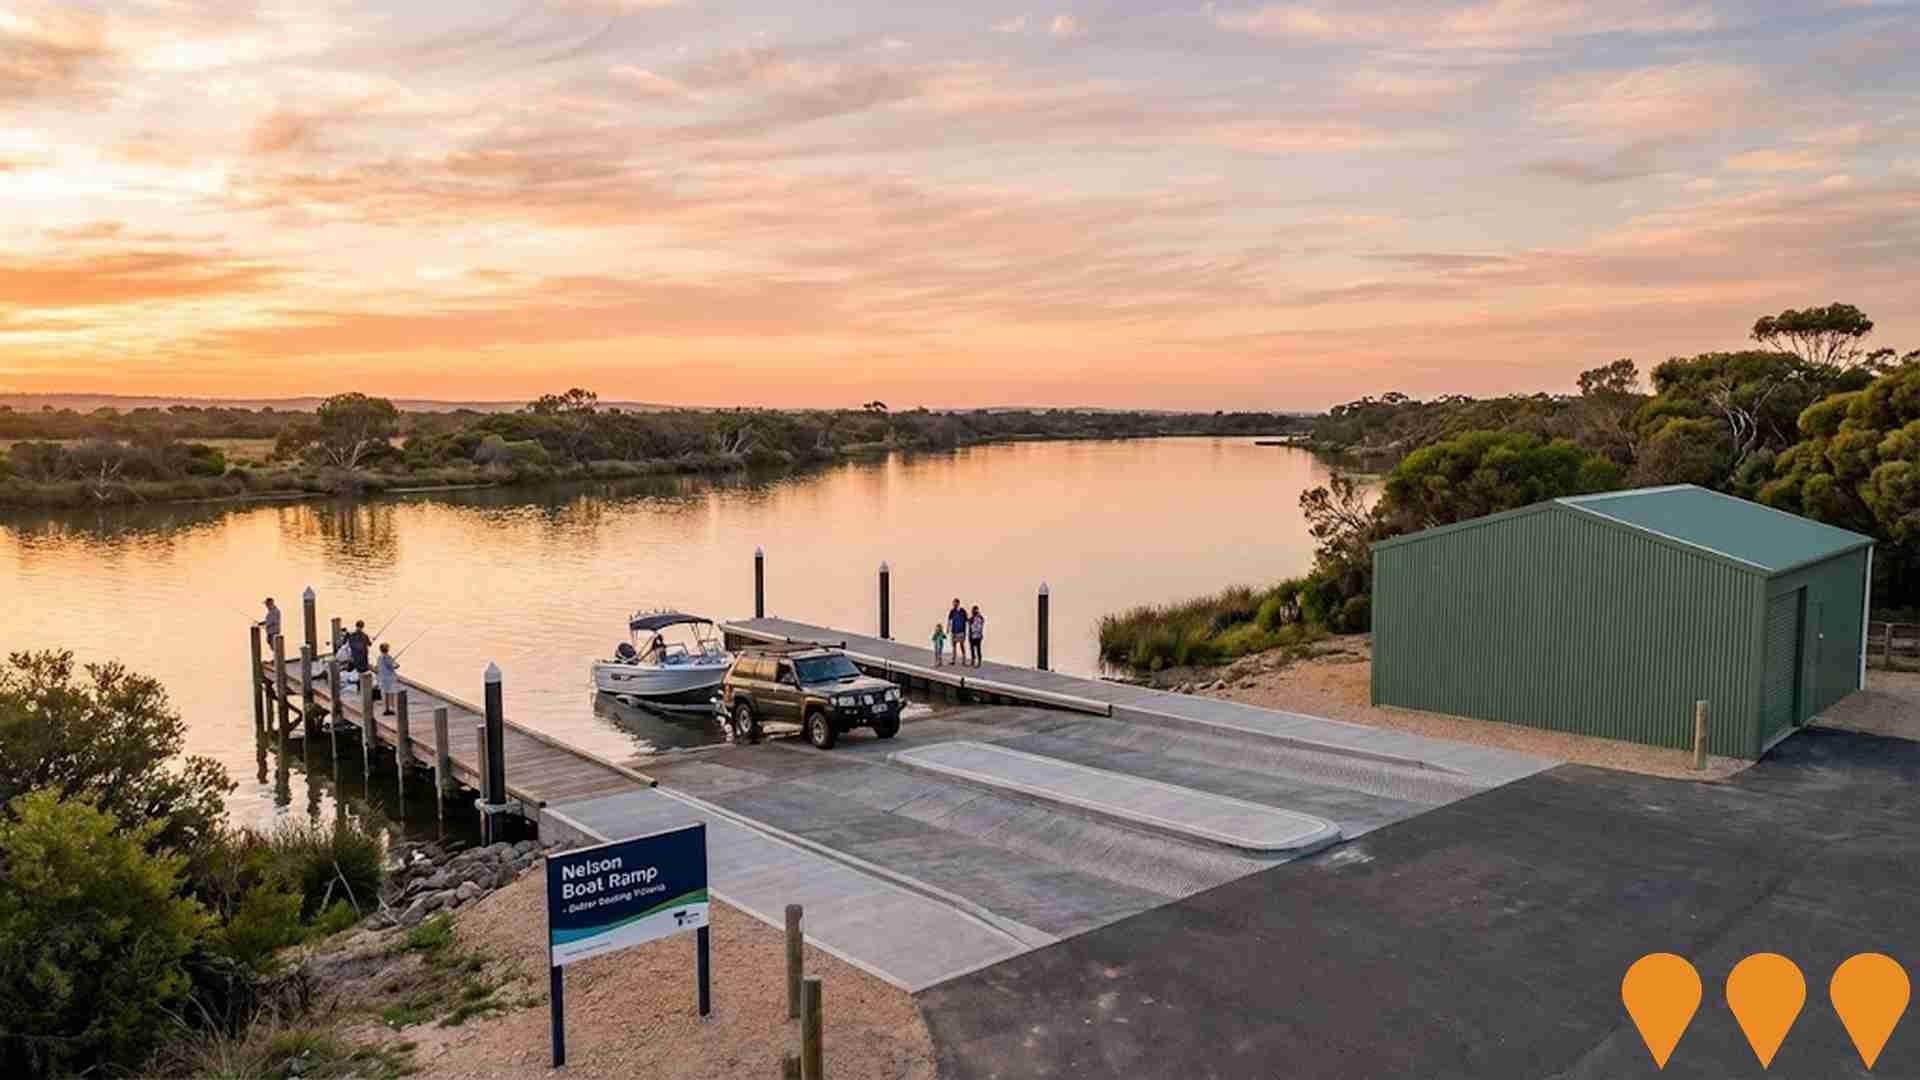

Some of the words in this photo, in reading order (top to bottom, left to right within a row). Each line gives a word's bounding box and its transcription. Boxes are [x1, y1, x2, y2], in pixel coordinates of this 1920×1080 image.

[562, 856, 623, 880] Nelson
[562, 877, 605, 899] Boat
[609, 866, 659, 889] Ramp
